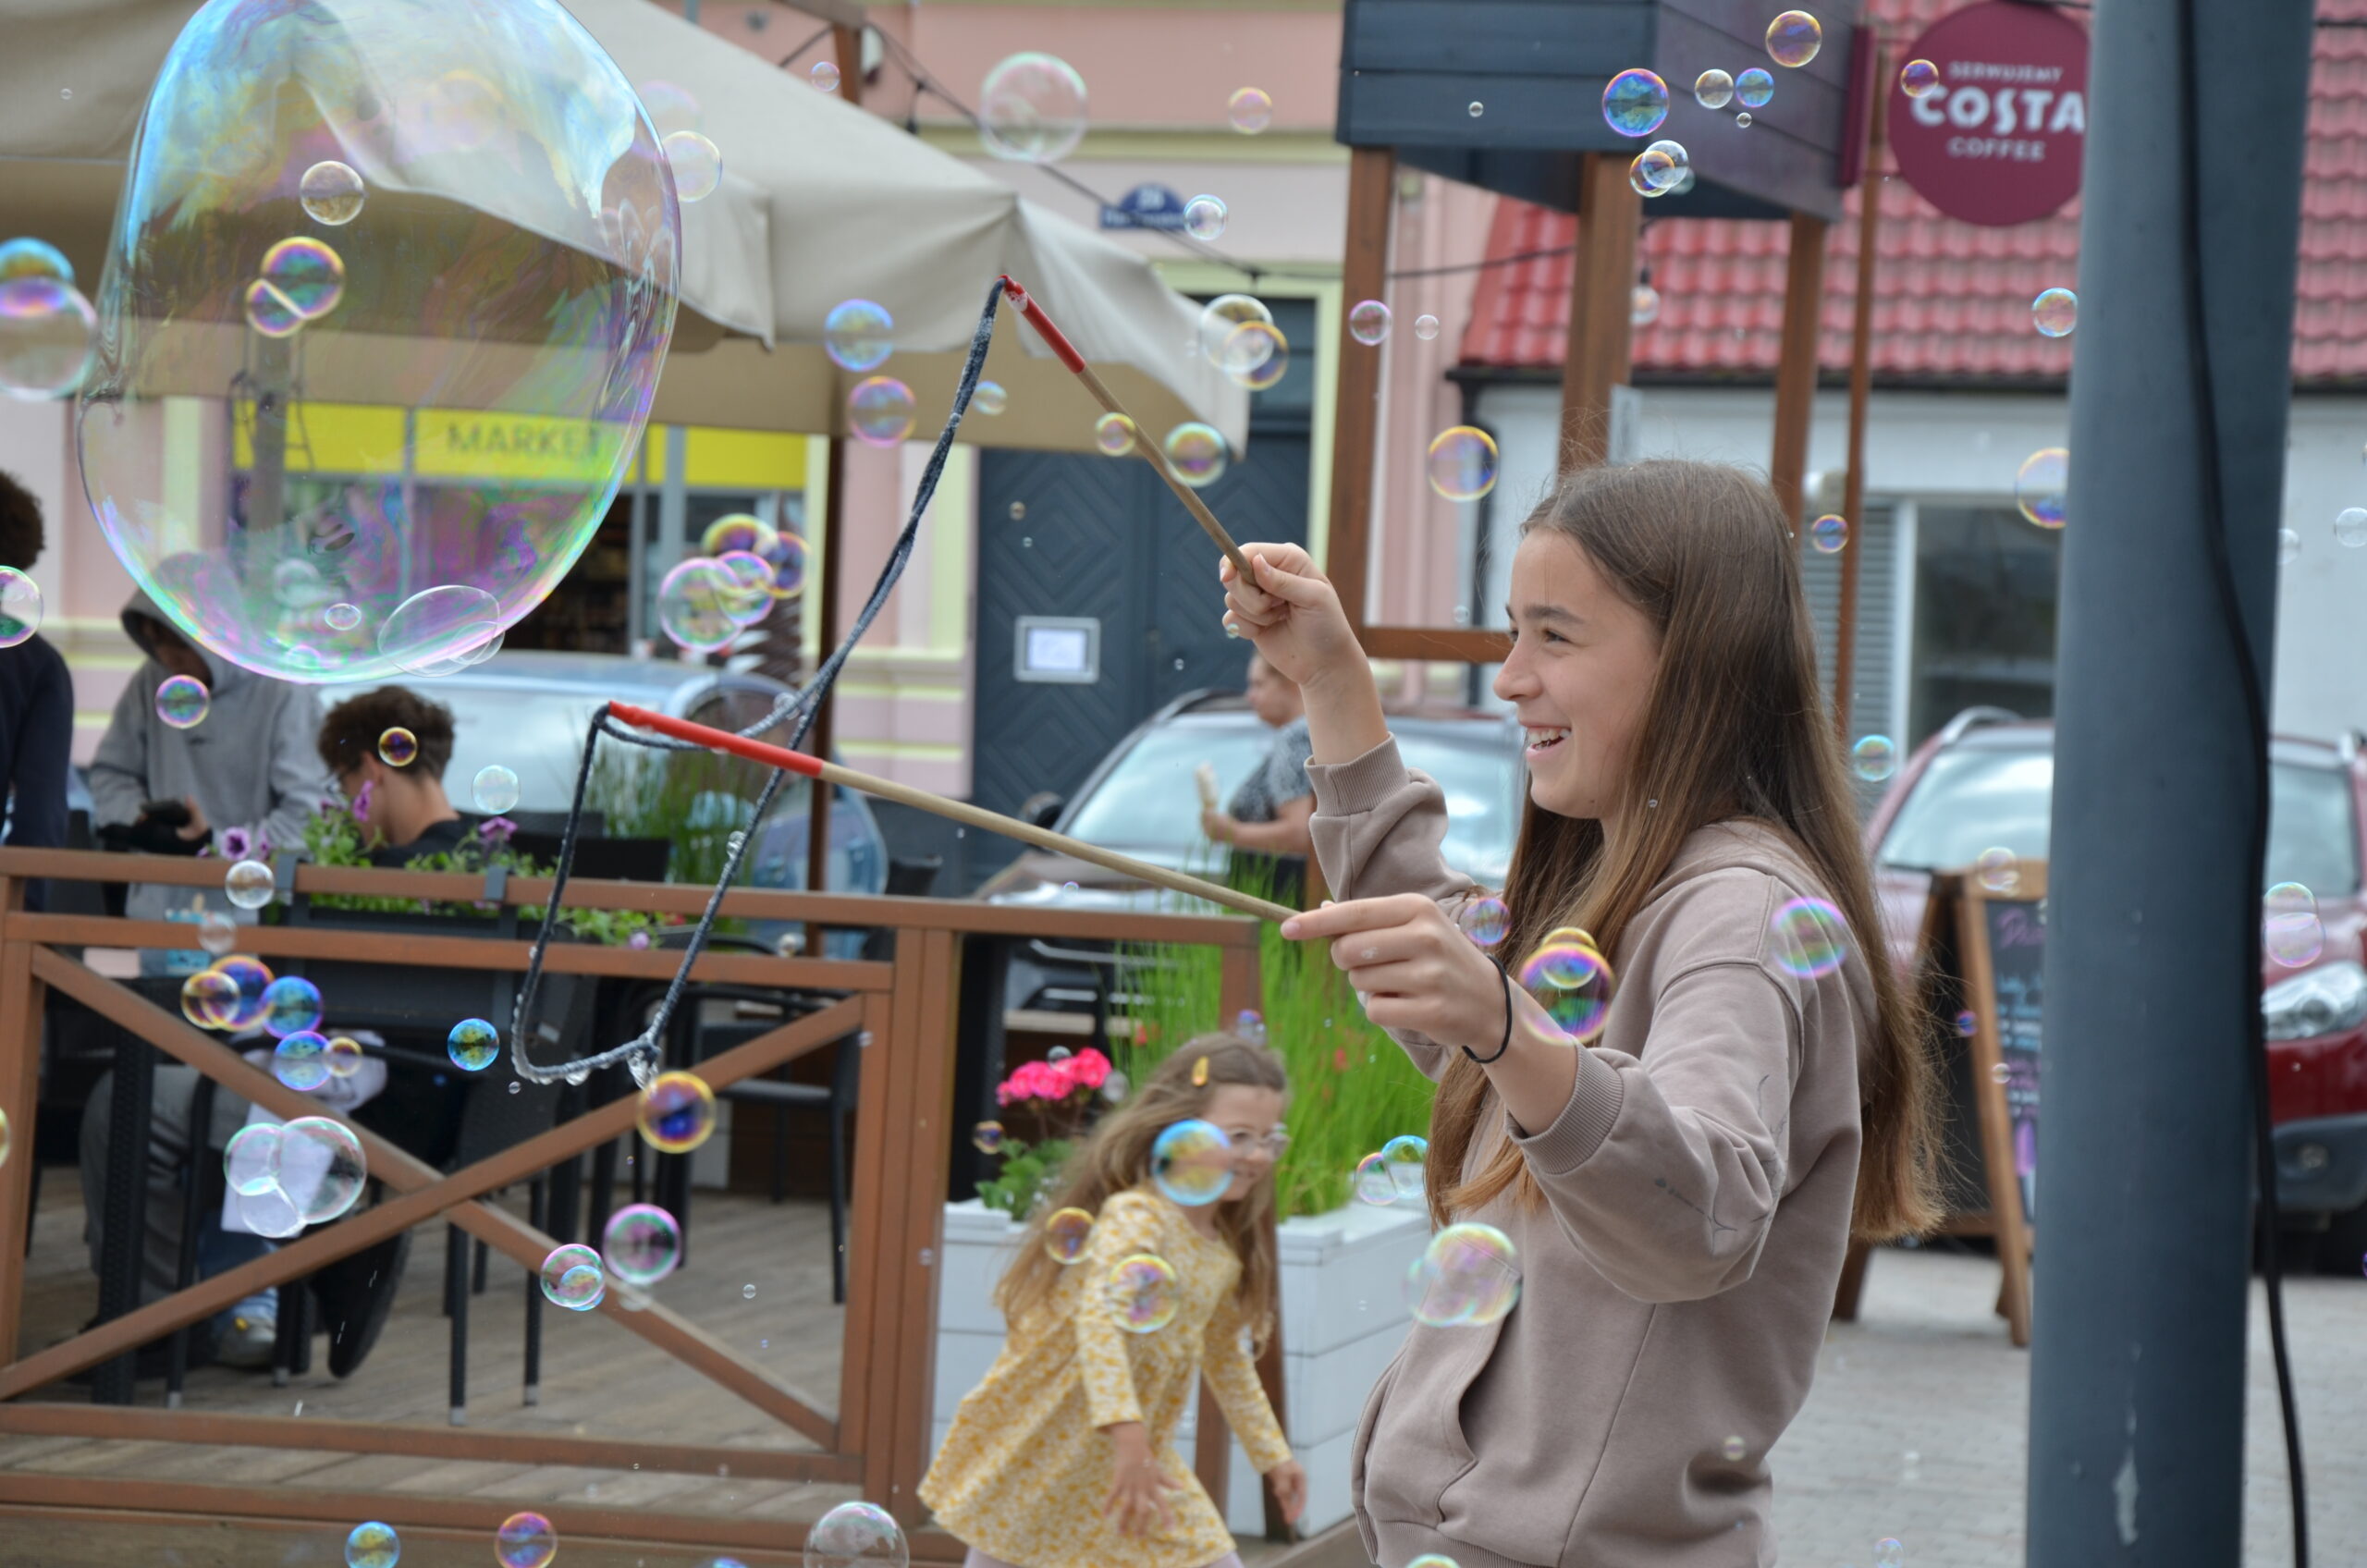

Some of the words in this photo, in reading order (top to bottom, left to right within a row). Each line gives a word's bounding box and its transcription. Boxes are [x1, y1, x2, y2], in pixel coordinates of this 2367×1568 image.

[1950, 62, 2062, 83] SERWUJEMY
[1910, 85, 2085, 135] COSTA
[1948, 138, 2045, 160] COFFEE
[448, 422, 601, 456] MARKET
